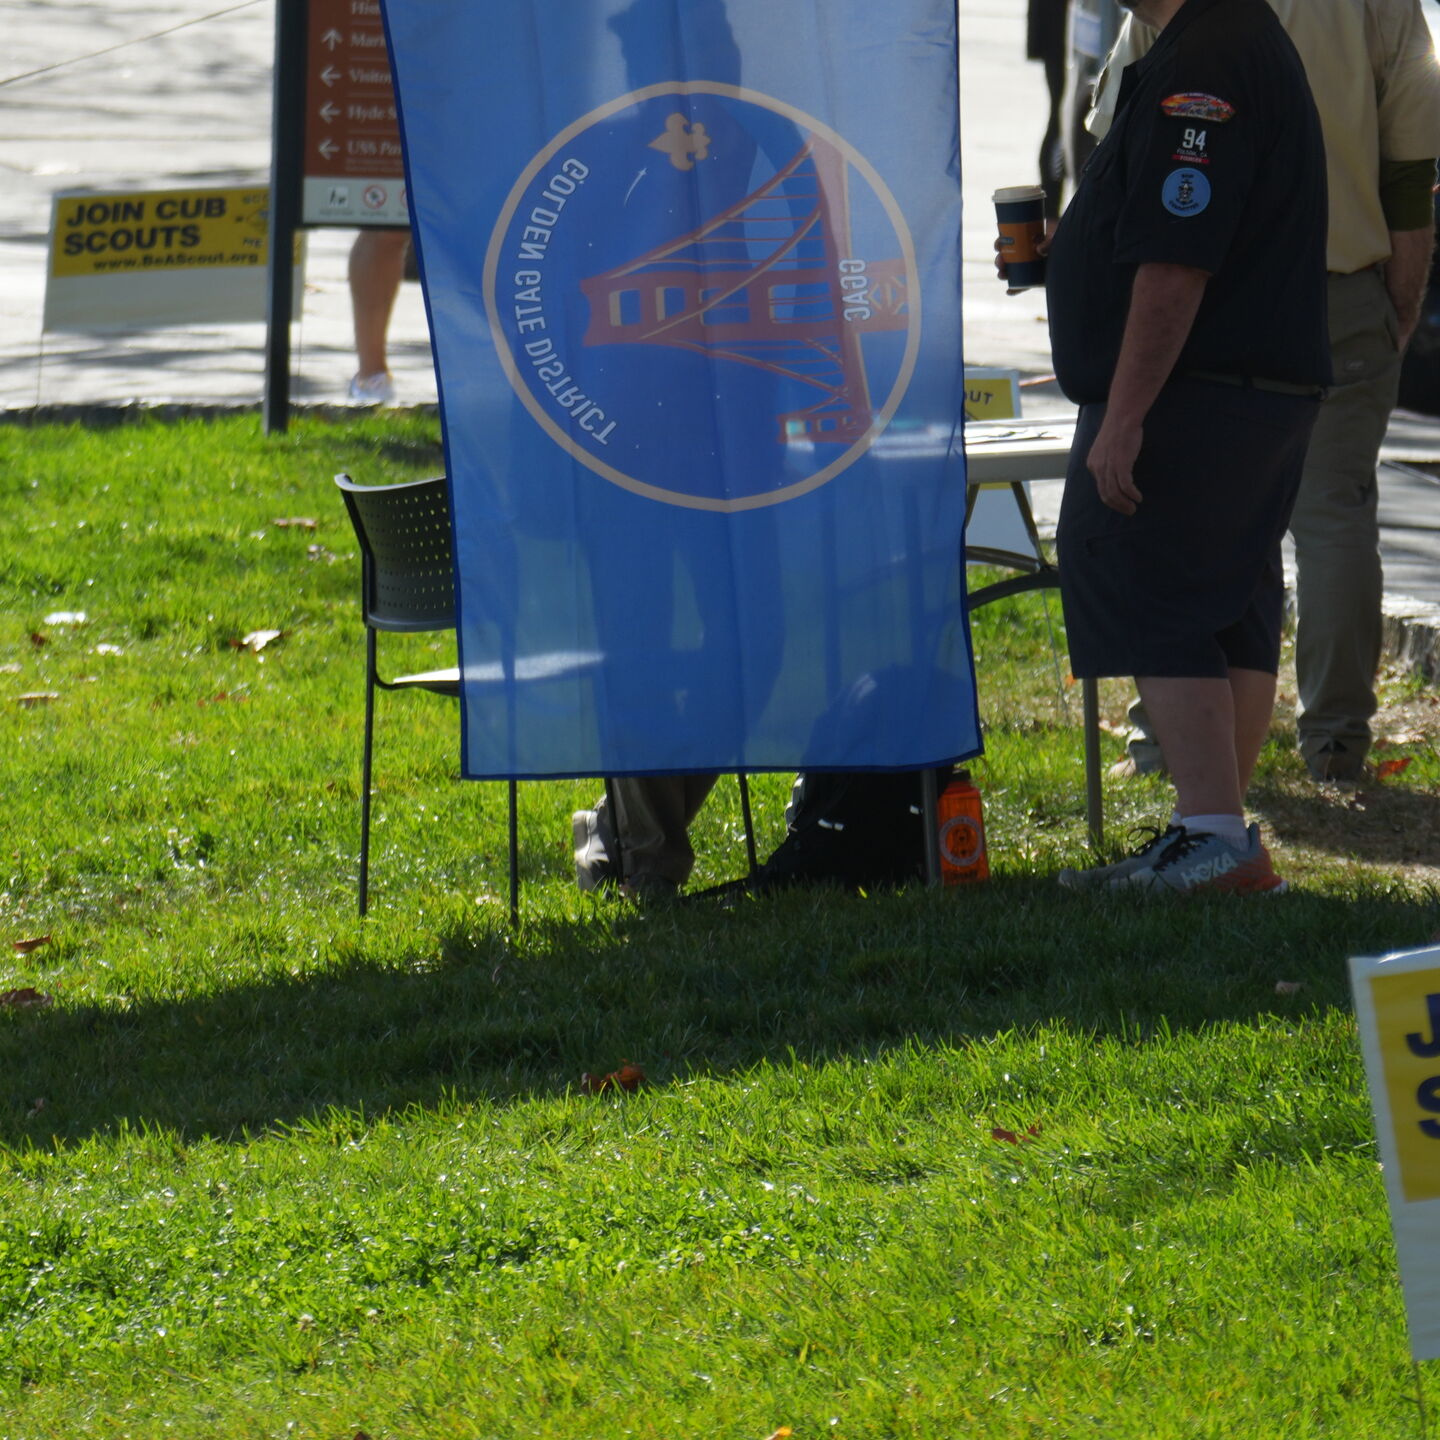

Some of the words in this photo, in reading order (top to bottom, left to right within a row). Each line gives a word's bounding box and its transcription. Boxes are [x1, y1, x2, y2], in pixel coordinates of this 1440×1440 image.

[1182, 128, 1207, 151] 94
[66, 201, 145, 227] JOIN
[155, 197, 227, 219] CUB
[63, 224, 201, 257] SCOUTS
[93, 252, 259, 272] www.BeAScout.org
